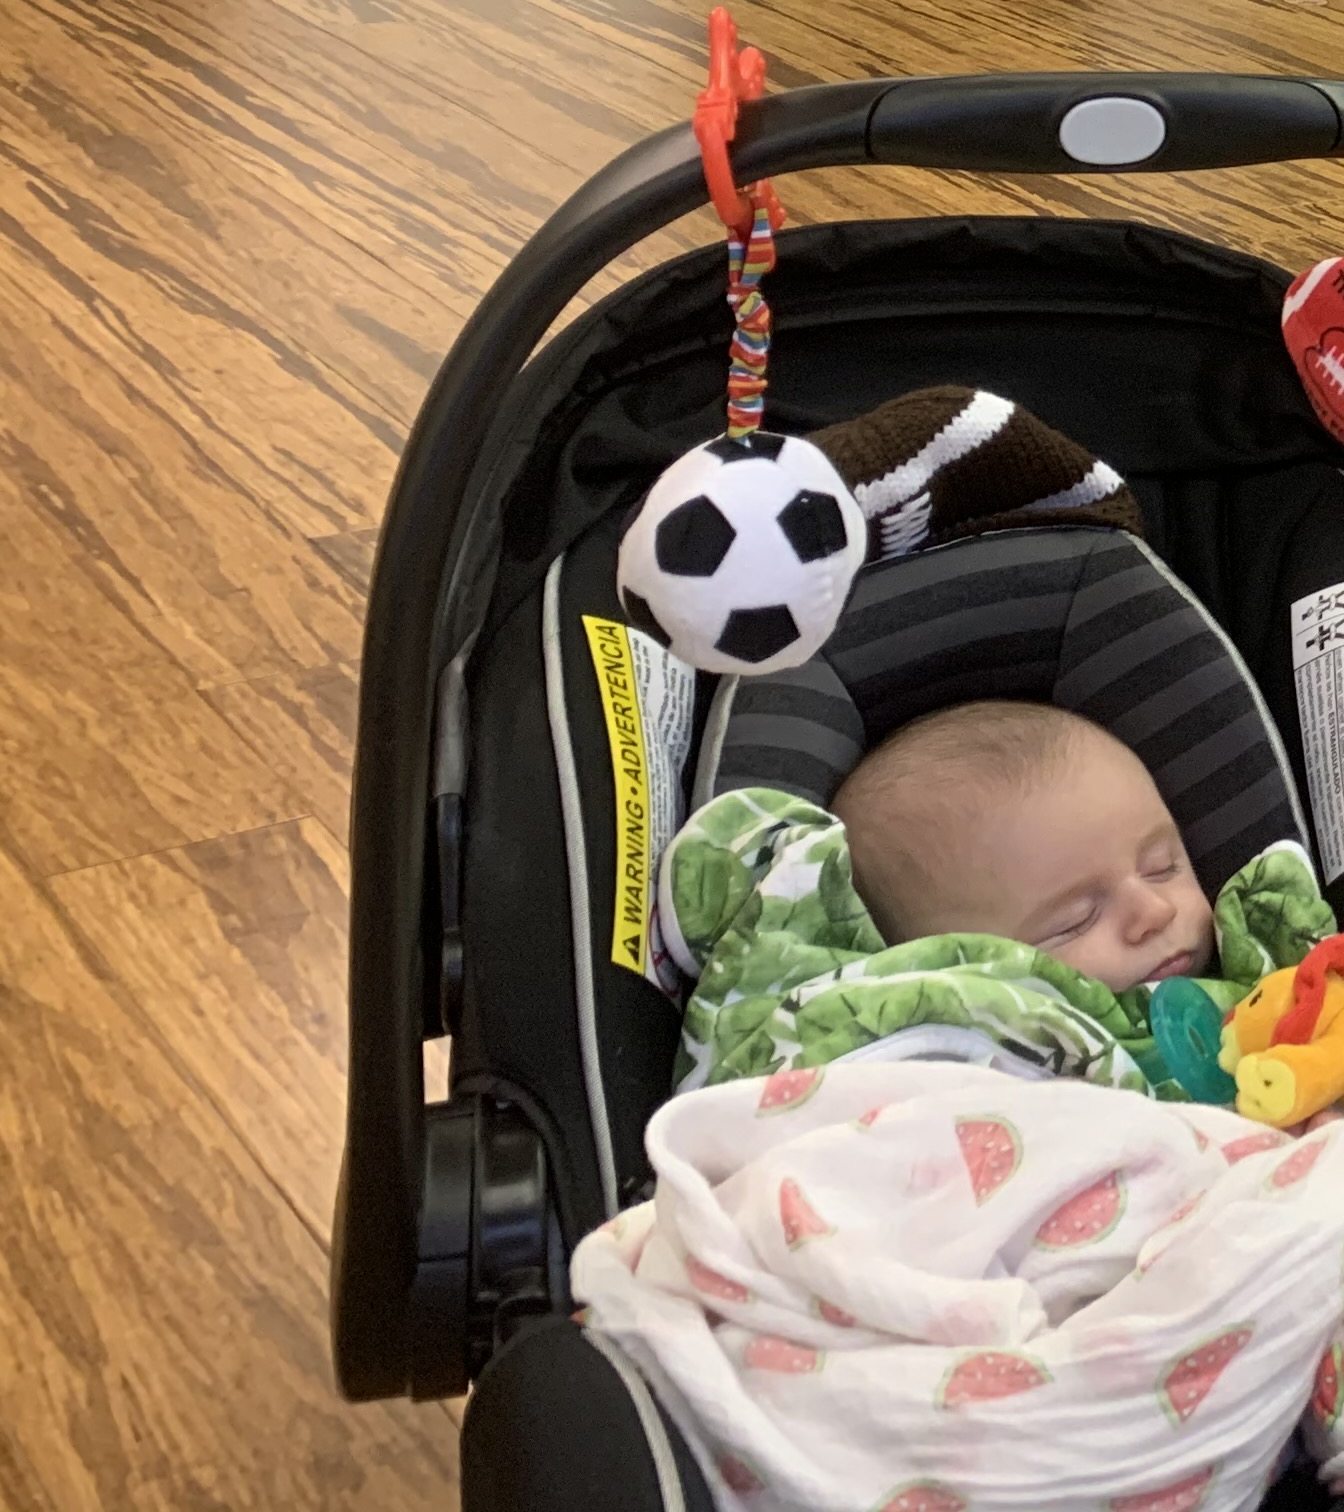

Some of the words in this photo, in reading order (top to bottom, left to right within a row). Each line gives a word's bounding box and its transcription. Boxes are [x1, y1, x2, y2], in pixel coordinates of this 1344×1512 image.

[597, 626, 641, 785] ADVERTENCIA
[1327, 711, 1340, 794] ESTRANGULADO
[624, 799, 645, 925] WARNING
